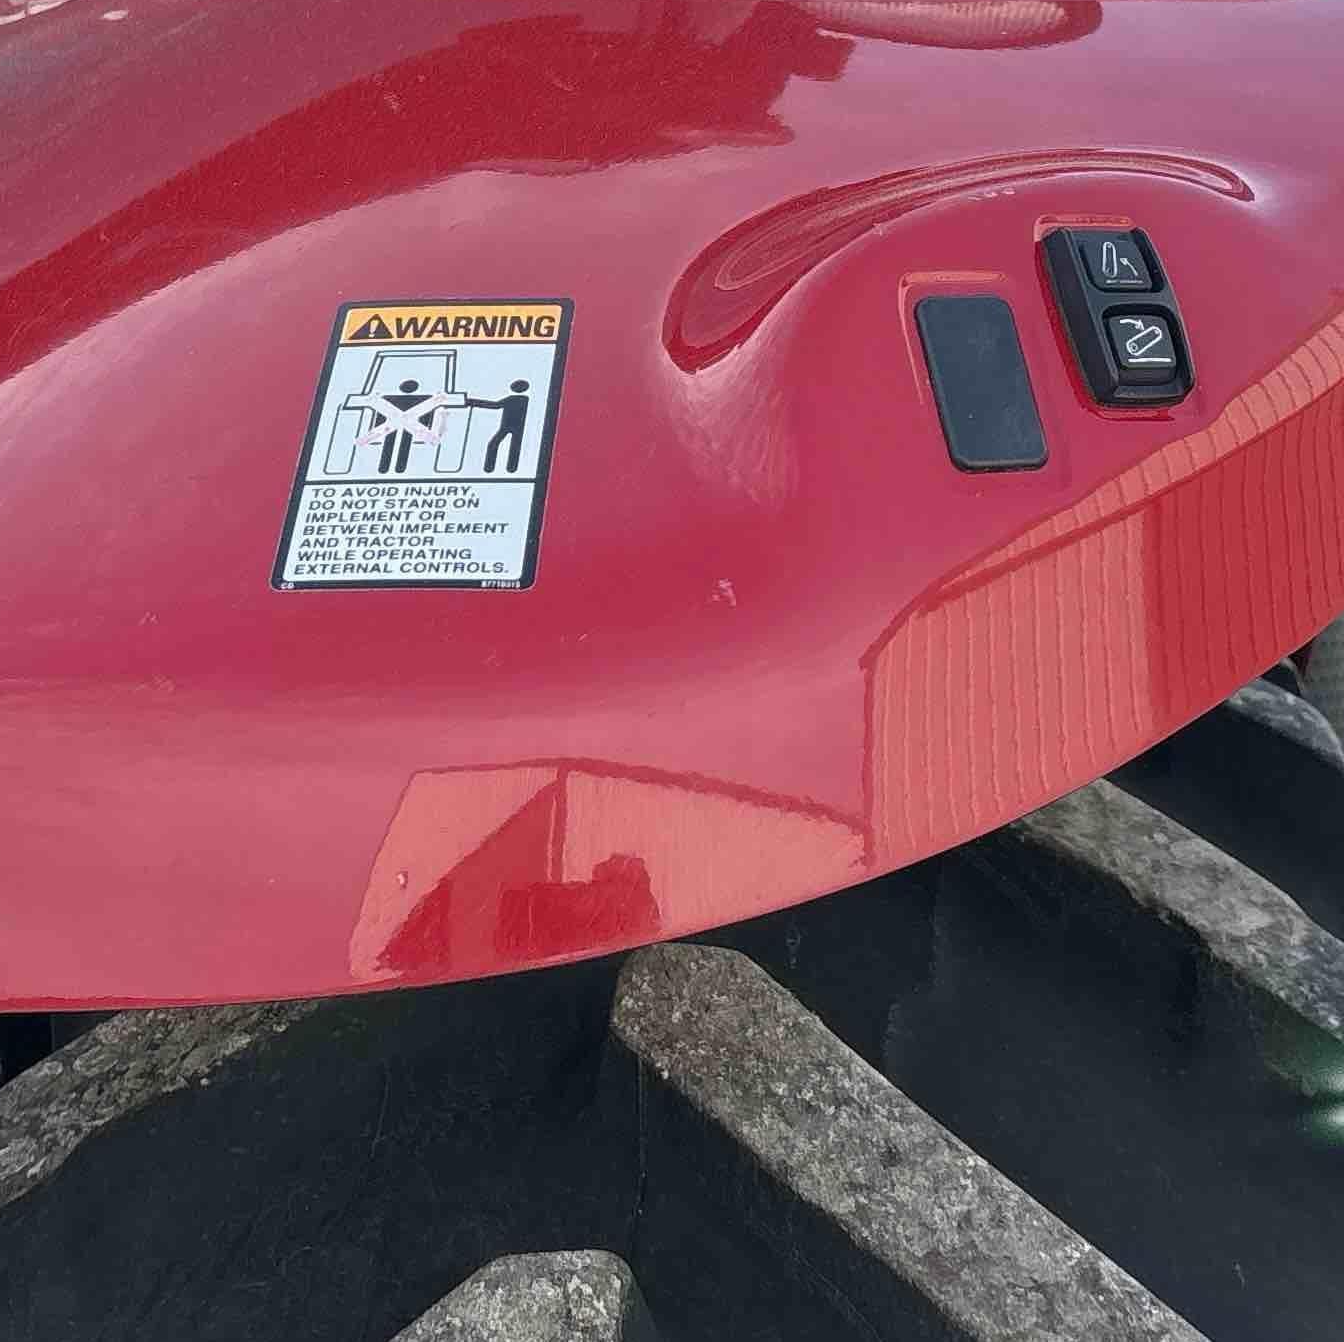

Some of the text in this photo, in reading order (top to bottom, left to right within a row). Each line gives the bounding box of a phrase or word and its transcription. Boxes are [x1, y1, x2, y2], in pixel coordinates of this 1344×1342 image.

[396, 315, 556, 339] WARNING
[312, 486, 476, 498] TO AVOID INJURY,
[309, 498, 480, 510] DO NOT STAND ON
[305, 511, 446, 523] IMPLEMENT OR
[303, 522, 510, 535] BETWEEN IMPLEMENT
[299, 536, 435, 548] AND TRACTOR
[298, 548, 473, 561] WHILE OPERATING
[294, 561, 510, 575] EXTERNAL CONTROLS.
